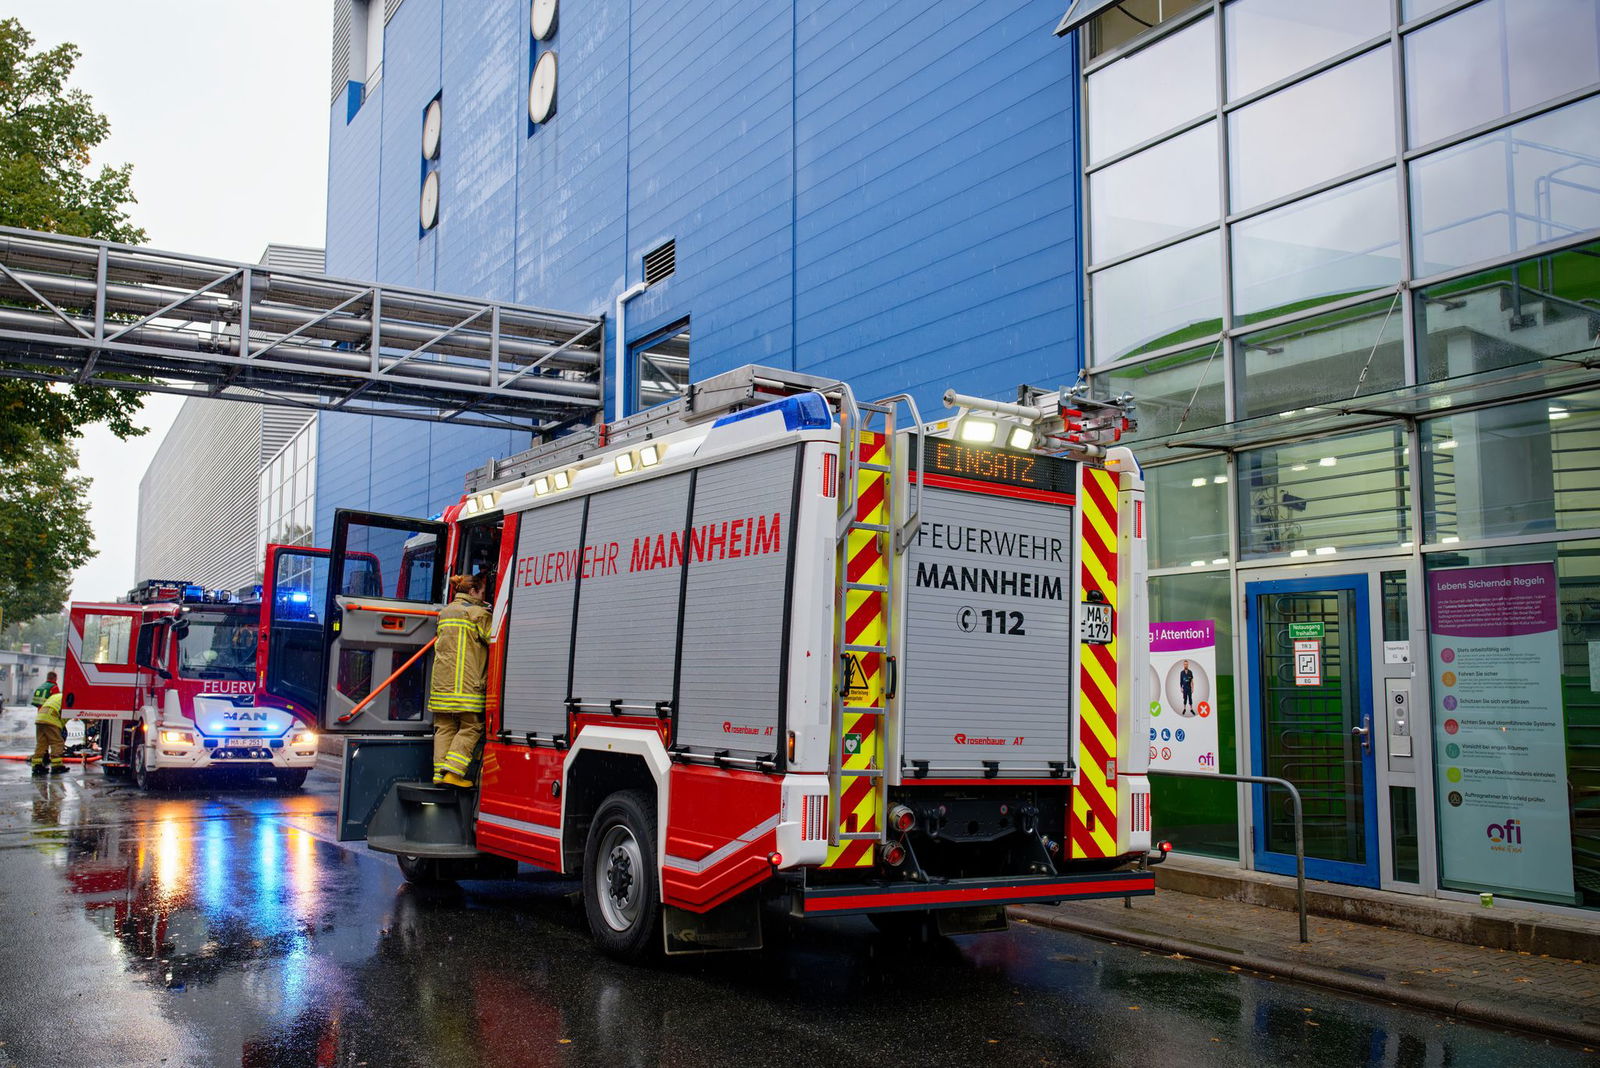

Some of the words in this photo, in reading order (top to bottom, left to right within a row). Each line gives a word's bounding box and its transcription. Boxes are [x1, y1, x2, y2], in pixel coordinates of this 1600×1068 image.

[937, 442, 1035, 482] EINSATZ
[516, 542, 619, 588] FEUERWEHR
[629, 512, 780, 573] MANNHEIM
[918, 522, 1062, 562] FEUERWEHR
[916, 562, 1062, 600] MANNHEIM
[1437, 582, 1466, 590] Lebens
[1468, 578, 1512, 588] Sichernde
[1514, 576, 1545, 586] Regeln
[982, 609, 1025, 636] 112
[1088, 606, 1102, 622] MA
[1088, 623, 1108, 639] 179
[1160, 628, 1204, 640] Attention
[224, 712, 267, 720] MAN
[1013, 737, 1024, 745] AT
[1487, 819, 1521, 844] ofi
